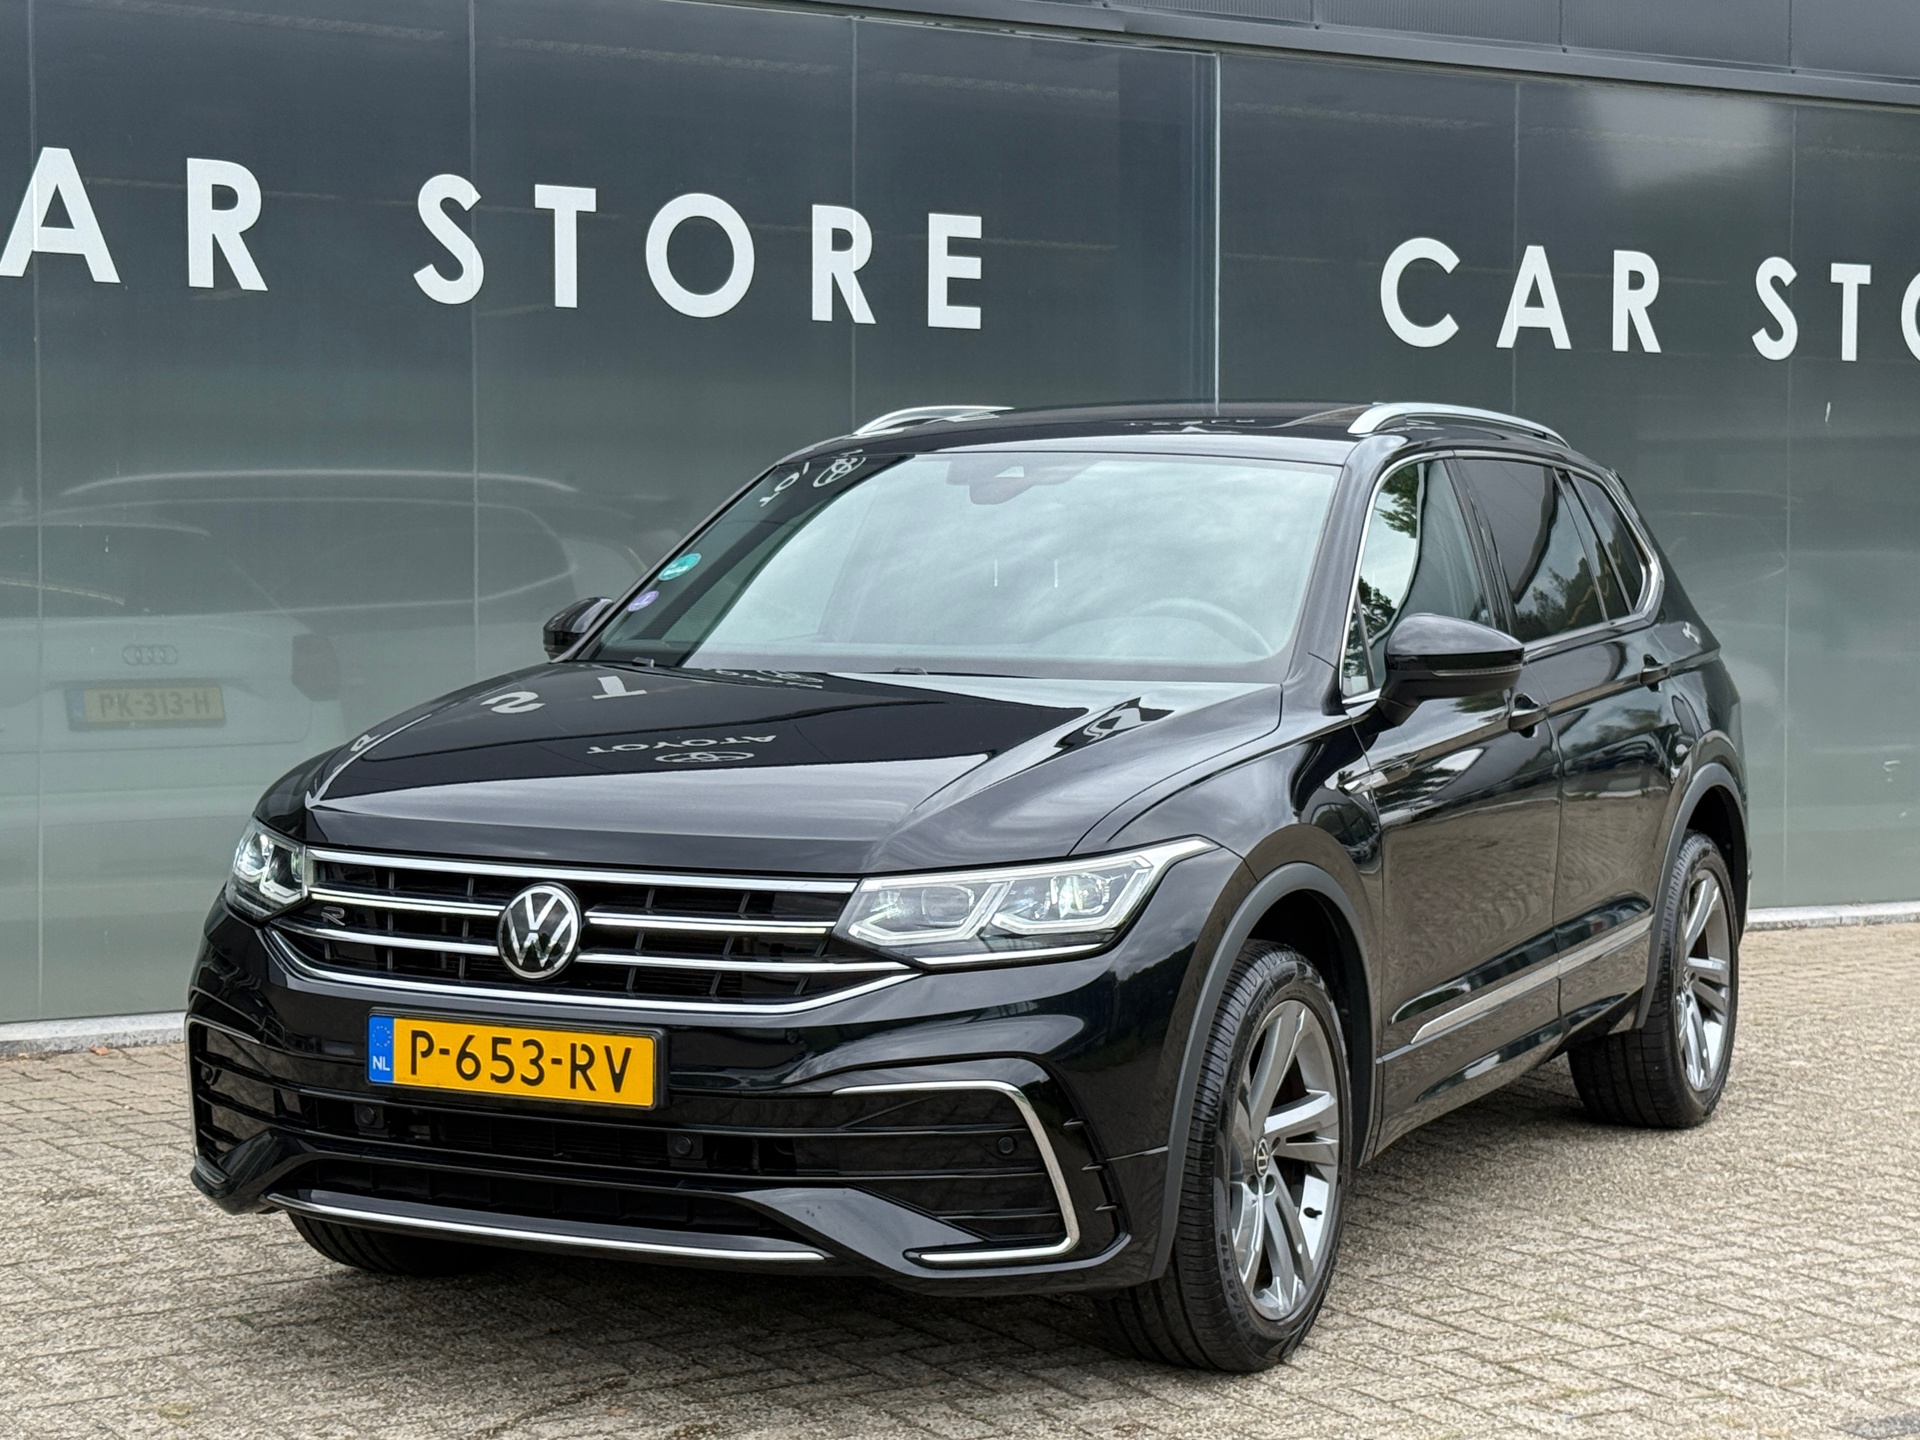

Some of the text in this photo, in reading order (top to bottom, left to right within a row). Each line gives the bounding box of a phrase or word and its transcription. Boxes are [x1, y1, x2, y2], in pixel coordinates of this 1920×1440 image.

[0, 146, 983, 331] AR STORE
[1380, 237, 1920, 362] CAR ST
[98, 691, 210, 718] PK-313-H
[372, 1055, 391, 1071] NL
[410, 1028, 633, 1094] P-653-RV
